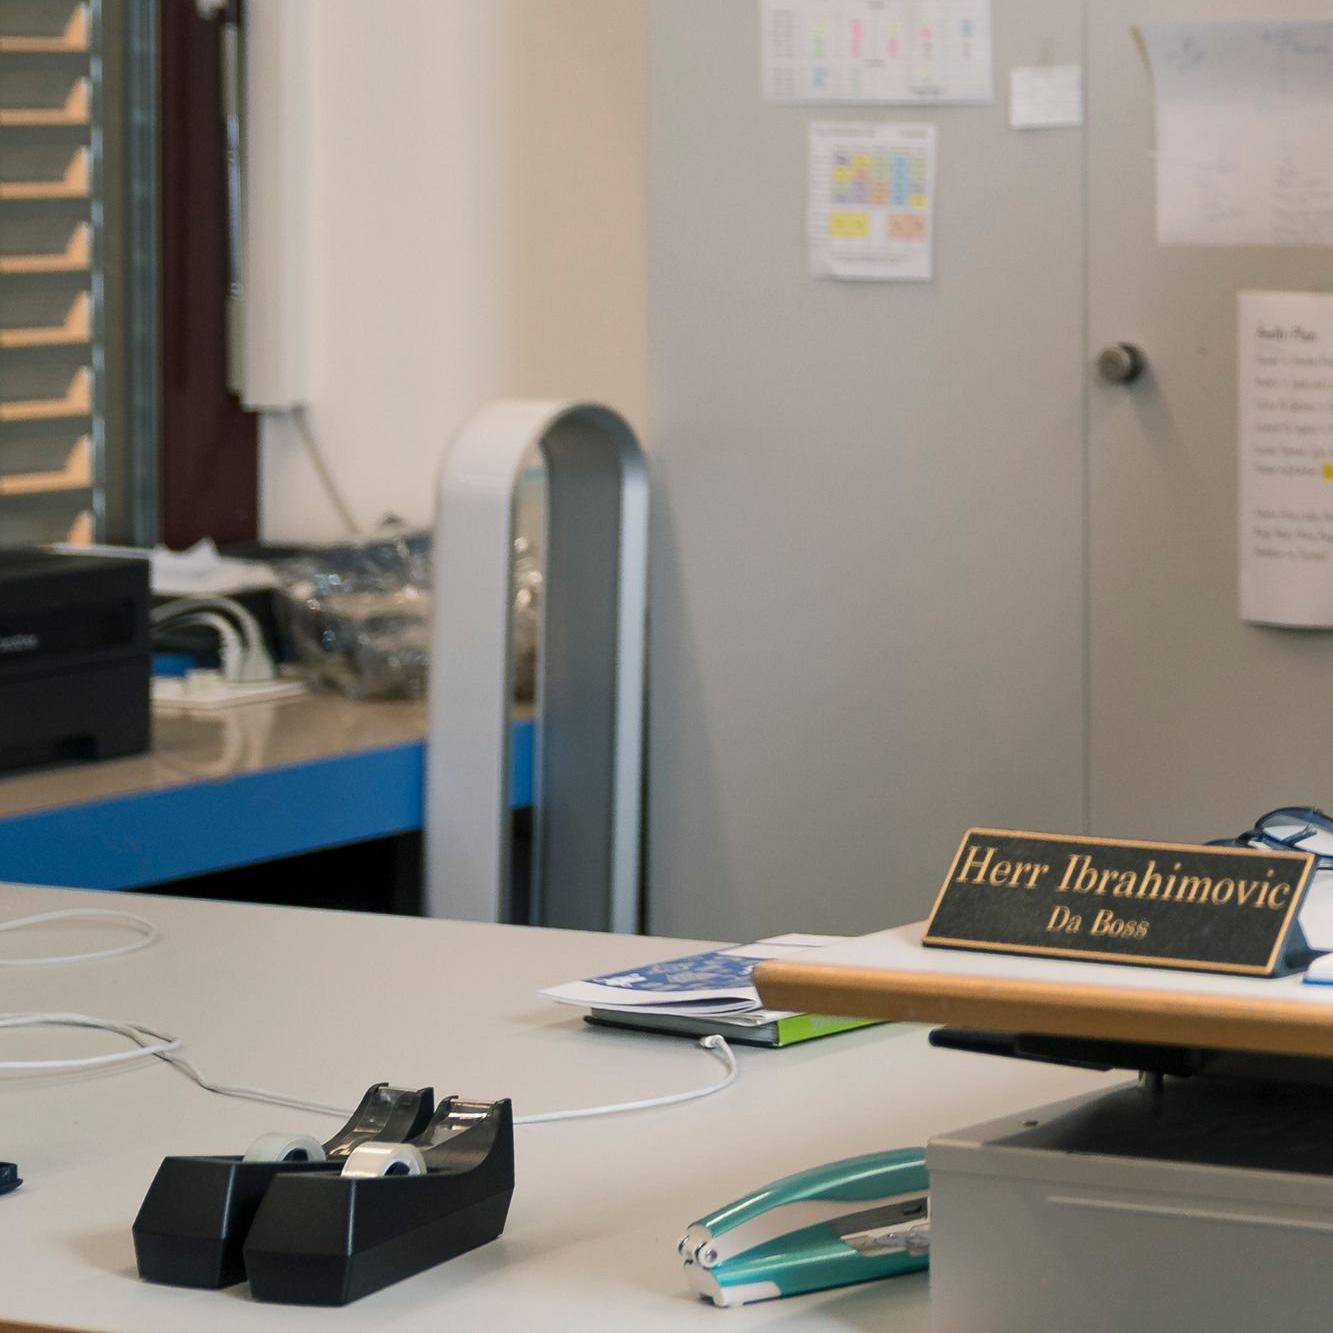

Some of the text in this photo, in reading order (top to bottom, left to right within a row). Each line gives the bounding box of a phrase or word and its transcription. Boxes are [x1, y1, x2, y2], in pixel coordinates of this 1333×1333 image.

[955, 845, 1292, 911] Herr Ibrahimovic
[1046, 905, 1150, 939] Da Boss
